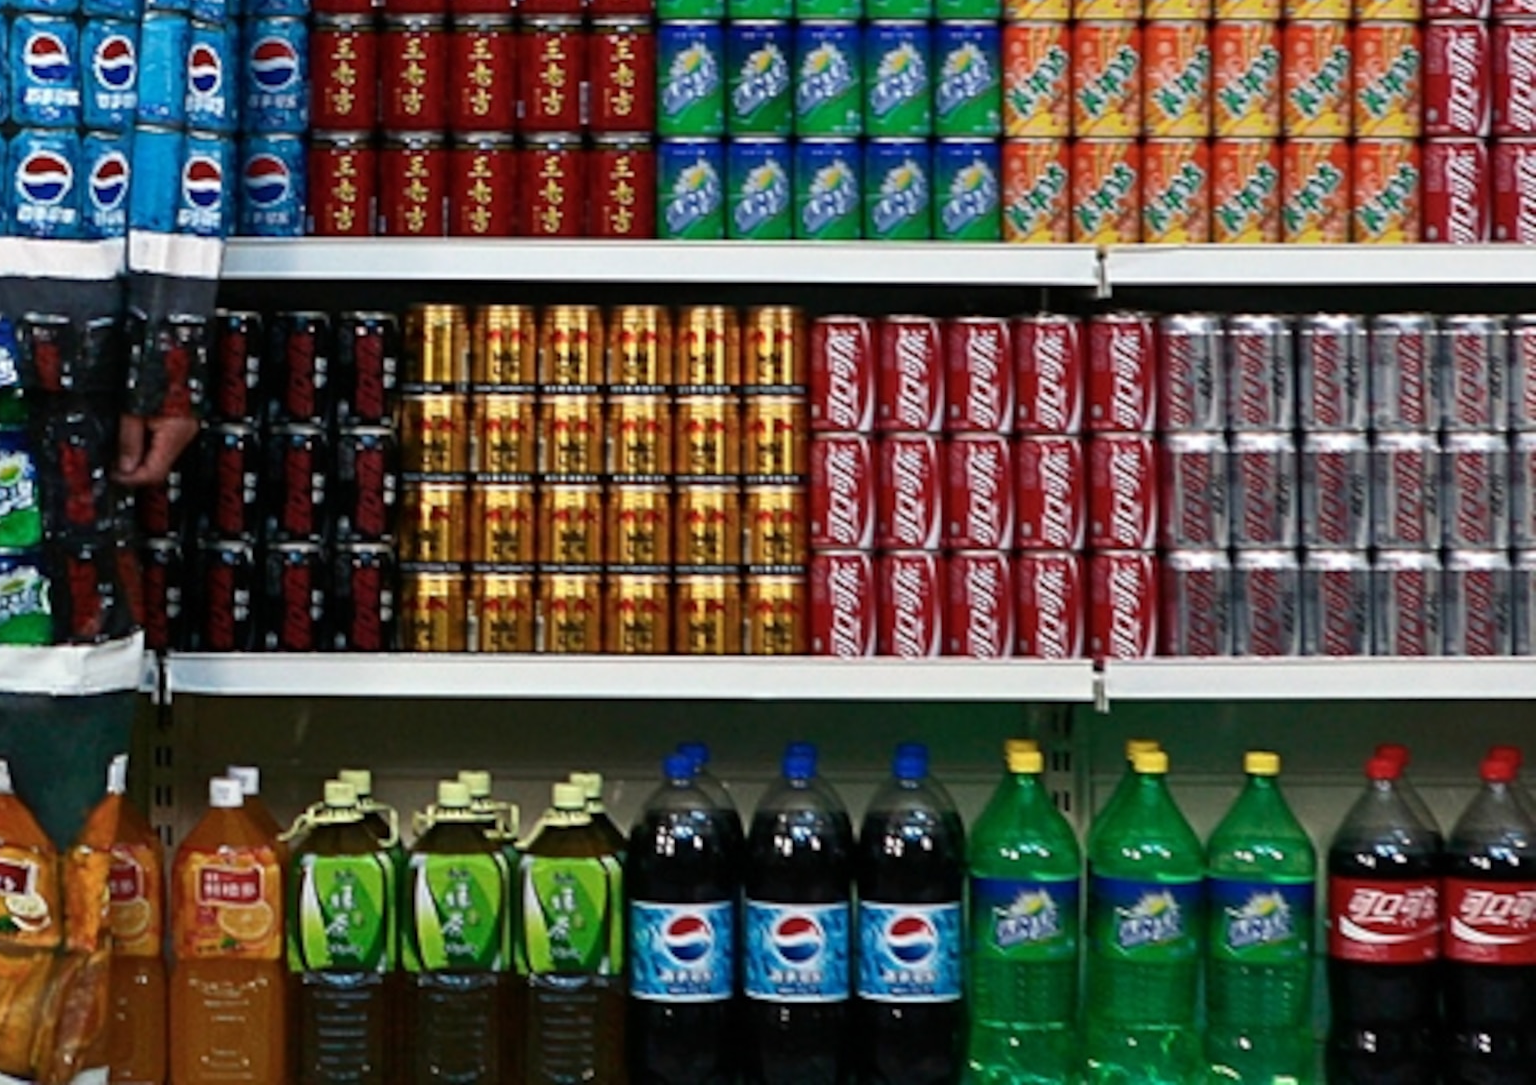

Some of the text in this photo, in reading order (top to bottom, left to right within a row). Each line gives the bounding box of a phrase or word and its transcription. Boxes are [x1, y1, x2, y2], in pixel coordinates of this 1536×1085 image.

[331, 37, 356, 115] 王老吉
[401, 37, 426, 115] 王老吉
[468, 37, 493, 115] 王老吉
[539, 37, 565, 115] 王老吉
[610, 37, 635, 115] 王老吉
[332, 155, 356, 232] 王老吉
[404, 155, 428, 232] 王老吉
[467, 155, 492, 232] 王老吉
[539, 155, 563, 232] 王老吉
[610, 155, 634, 232] 王老吉
